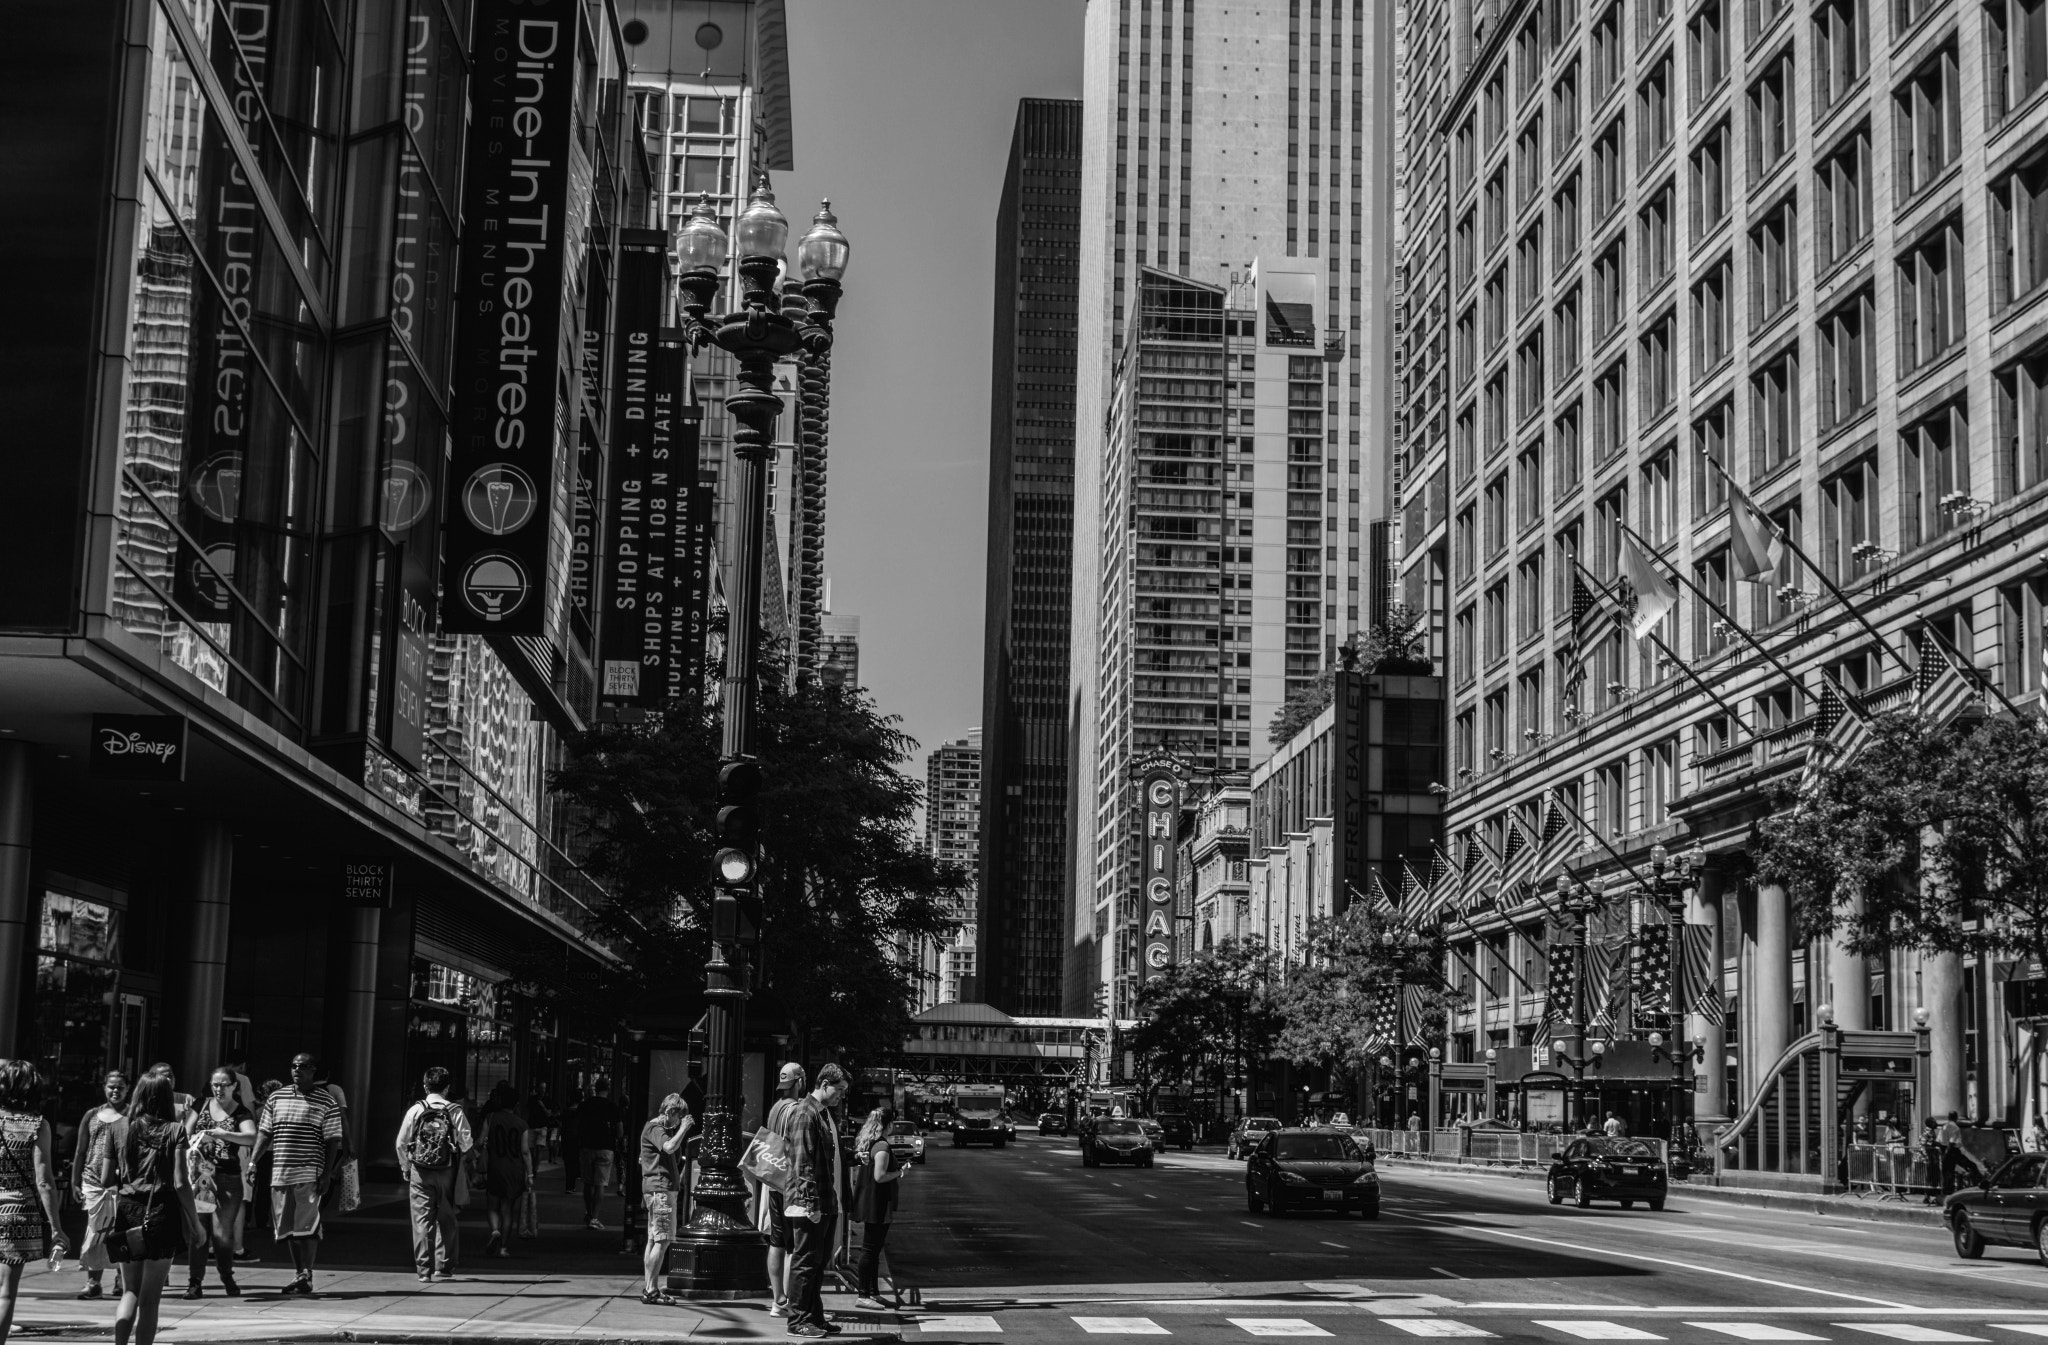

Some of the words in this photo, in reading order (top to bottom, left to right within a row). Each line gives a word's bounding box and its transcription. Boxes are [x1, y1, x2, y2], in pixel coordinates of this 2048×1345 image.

[478, 188, 500, 316] MENUS.
[625, 332, 649, 420] DINING
[653, 392, 672, 460] STATE
[626, 443, 641, 458] +
[651, 472, 668, 485] N
[649, 498, 667, 539] 108
[616, 479, 642, 610] SHOPPING
[647, 552, 665, 579] AT
[402, 588, 427, 644] BLOCK
[643, 591, 664, 667] SHOPS
[609, 666, 636, 674] BLOCK
[609, 674, 636, 682] THIRTY
[609, 682, 634, 690] SEVEN
[399, 680, 421, 728] SEVEN
[1346, 675, 1360, 783] BALLET
[1140, 759, 1173, 772] CHASE
[1345, 789, 1358, 881] FFREY
[346, 864, 384, 875] BLOCK
[346, 876, 384, 886] THIRTY
[1145, 779, 1173, 984] CHICAG
[345, 887, 381, 898] SEVEN
